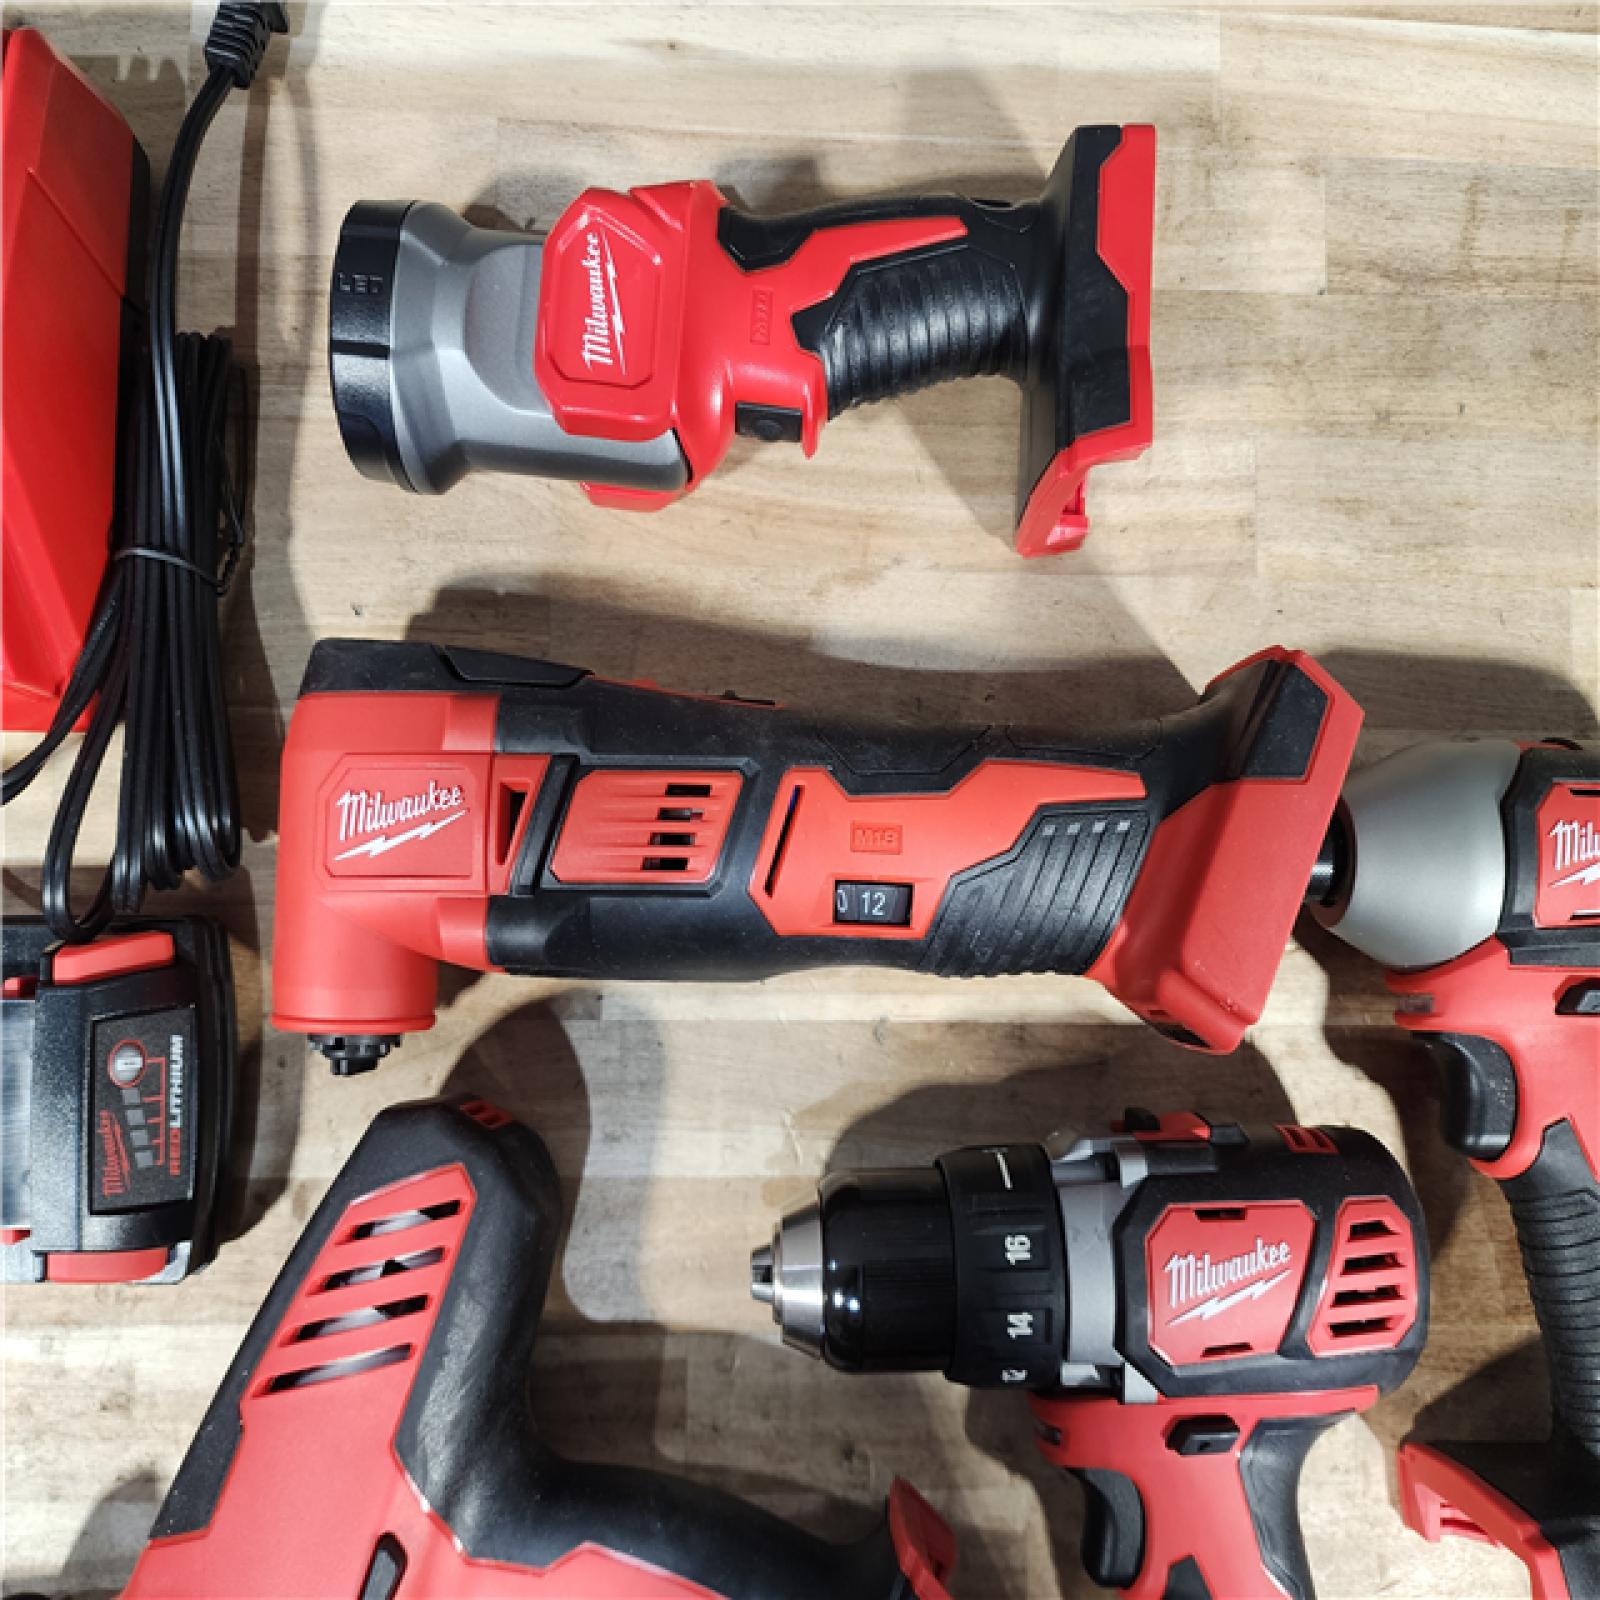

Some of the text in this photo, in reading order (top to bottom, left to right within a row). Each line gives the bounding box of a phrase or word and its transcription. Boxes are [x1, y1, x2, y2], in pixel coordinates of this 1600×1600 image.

[582, 232, 613, 371] Milwaukee
[337, 780, 463, 842] Milwaukee
[862, 891, 886, 916] 12
[1005, 1234, 1031, 1265] 16
[1164, 1237, 1291, 1309] Milwaukee
[1007, 1312, 1033, 1339] 14
